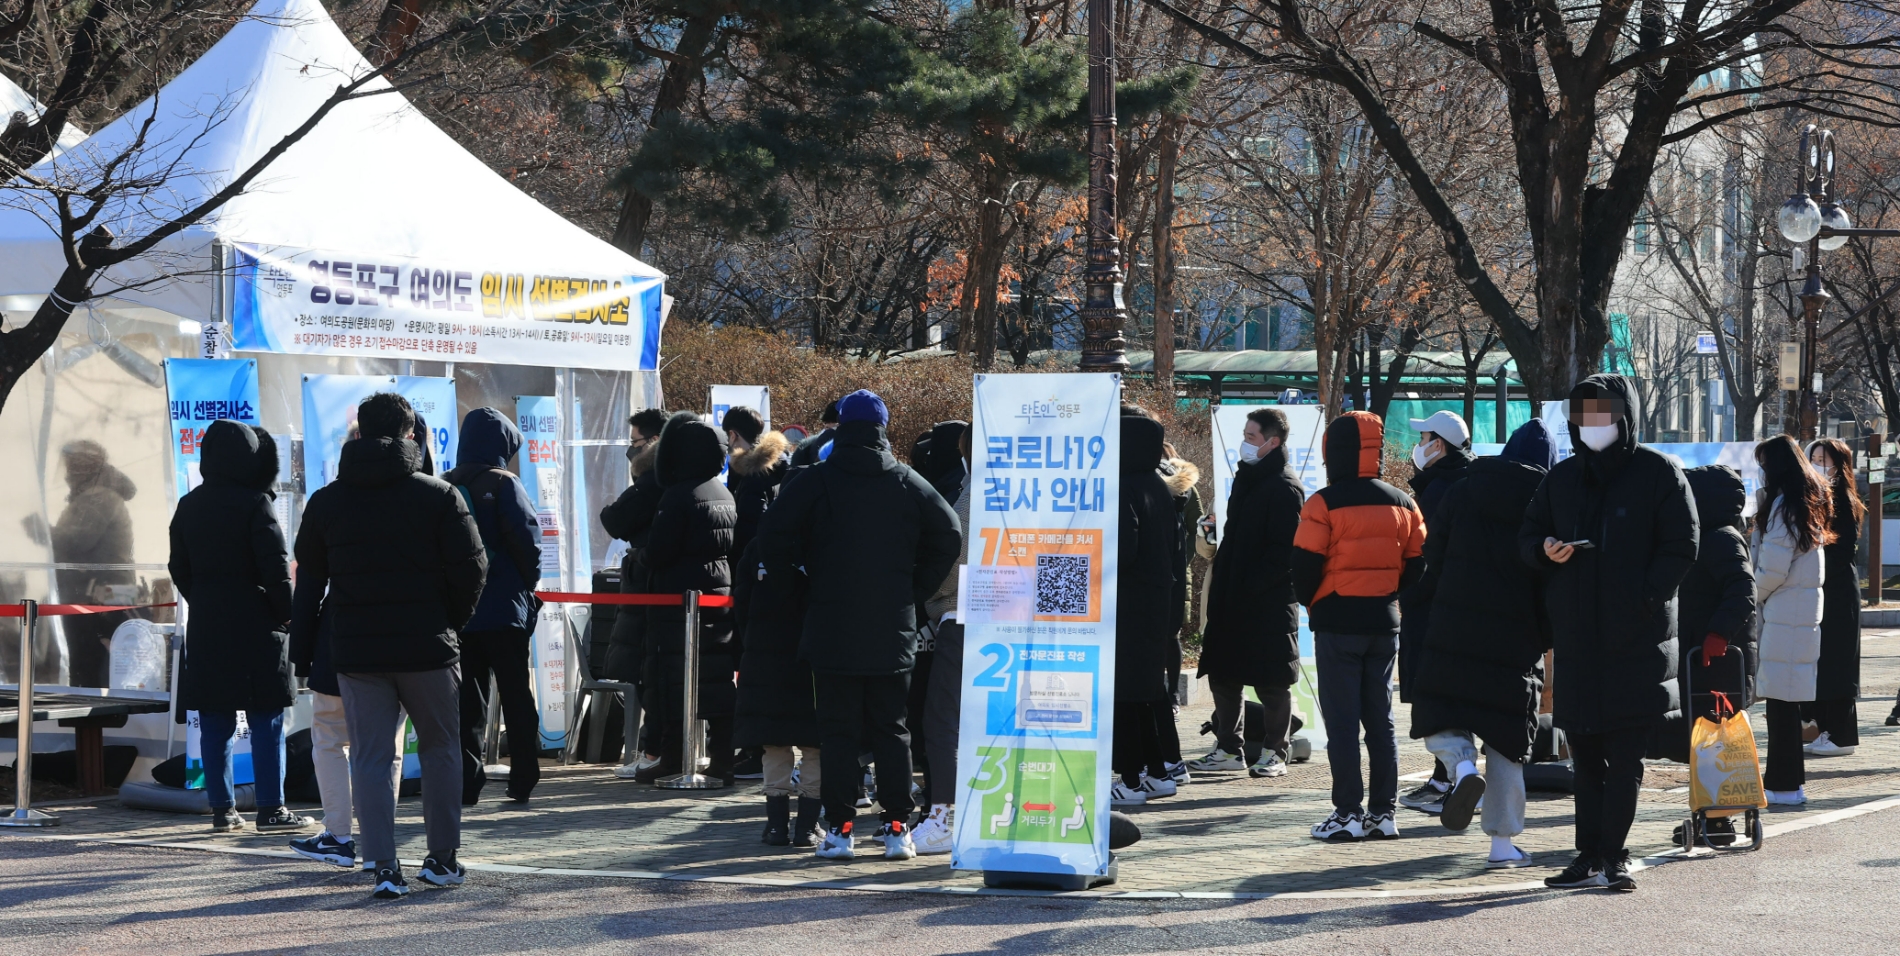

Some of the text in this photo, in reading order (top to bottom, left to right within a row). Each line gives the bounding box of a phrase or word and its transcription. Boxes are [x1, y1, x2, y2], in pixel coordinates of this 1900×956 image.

[308, 260, 399, 307] 영등포구
[410, 267, 474, 312] 여의도
[480, 270, 526, 320] 임시
[438, 323, 450, 335] 평일
[204, 326, 218, 359] 순찰
[303, 332, 331, 346] 대기자가
[333, 334, 347, 348] 많은
[349, 335, 362, 348] 경우
[421, 339, 434, 352] 단축
[436, 339, 455, 353] 운영될
[457, 341, 463, 353] 수
[465, 342, 477, 354] 있음
[171, 401, 254, 420] 임시 선별검사소
[1015, 400, 1080, 424] 탁트인 영등포
[520, 415, 536, 432] 임시
[986, 435, 1105, 470] 코로나19
[984, 477, 1105, 512] 검사 안내
[979, 528, 1001, 566] 1
[1009, 534, 1094, 545] 휴대폰 카메라를 켜서
[1008, 547, 1027, 557] 스캔
[549, 659, 564, 668] 대기자
[1019, 649, 1086, 662] 전자문진표 작성
[972, 643, 1011, 687] 2
[967, 746, 1008, 791] 3
[1018, 761, 1056, 773] 순번대기
[1721, 782, 1758, 796] SAVE
[1718, 797, 1738, 806] OUR
[1021, 815, 1056, 827] 거리두기
